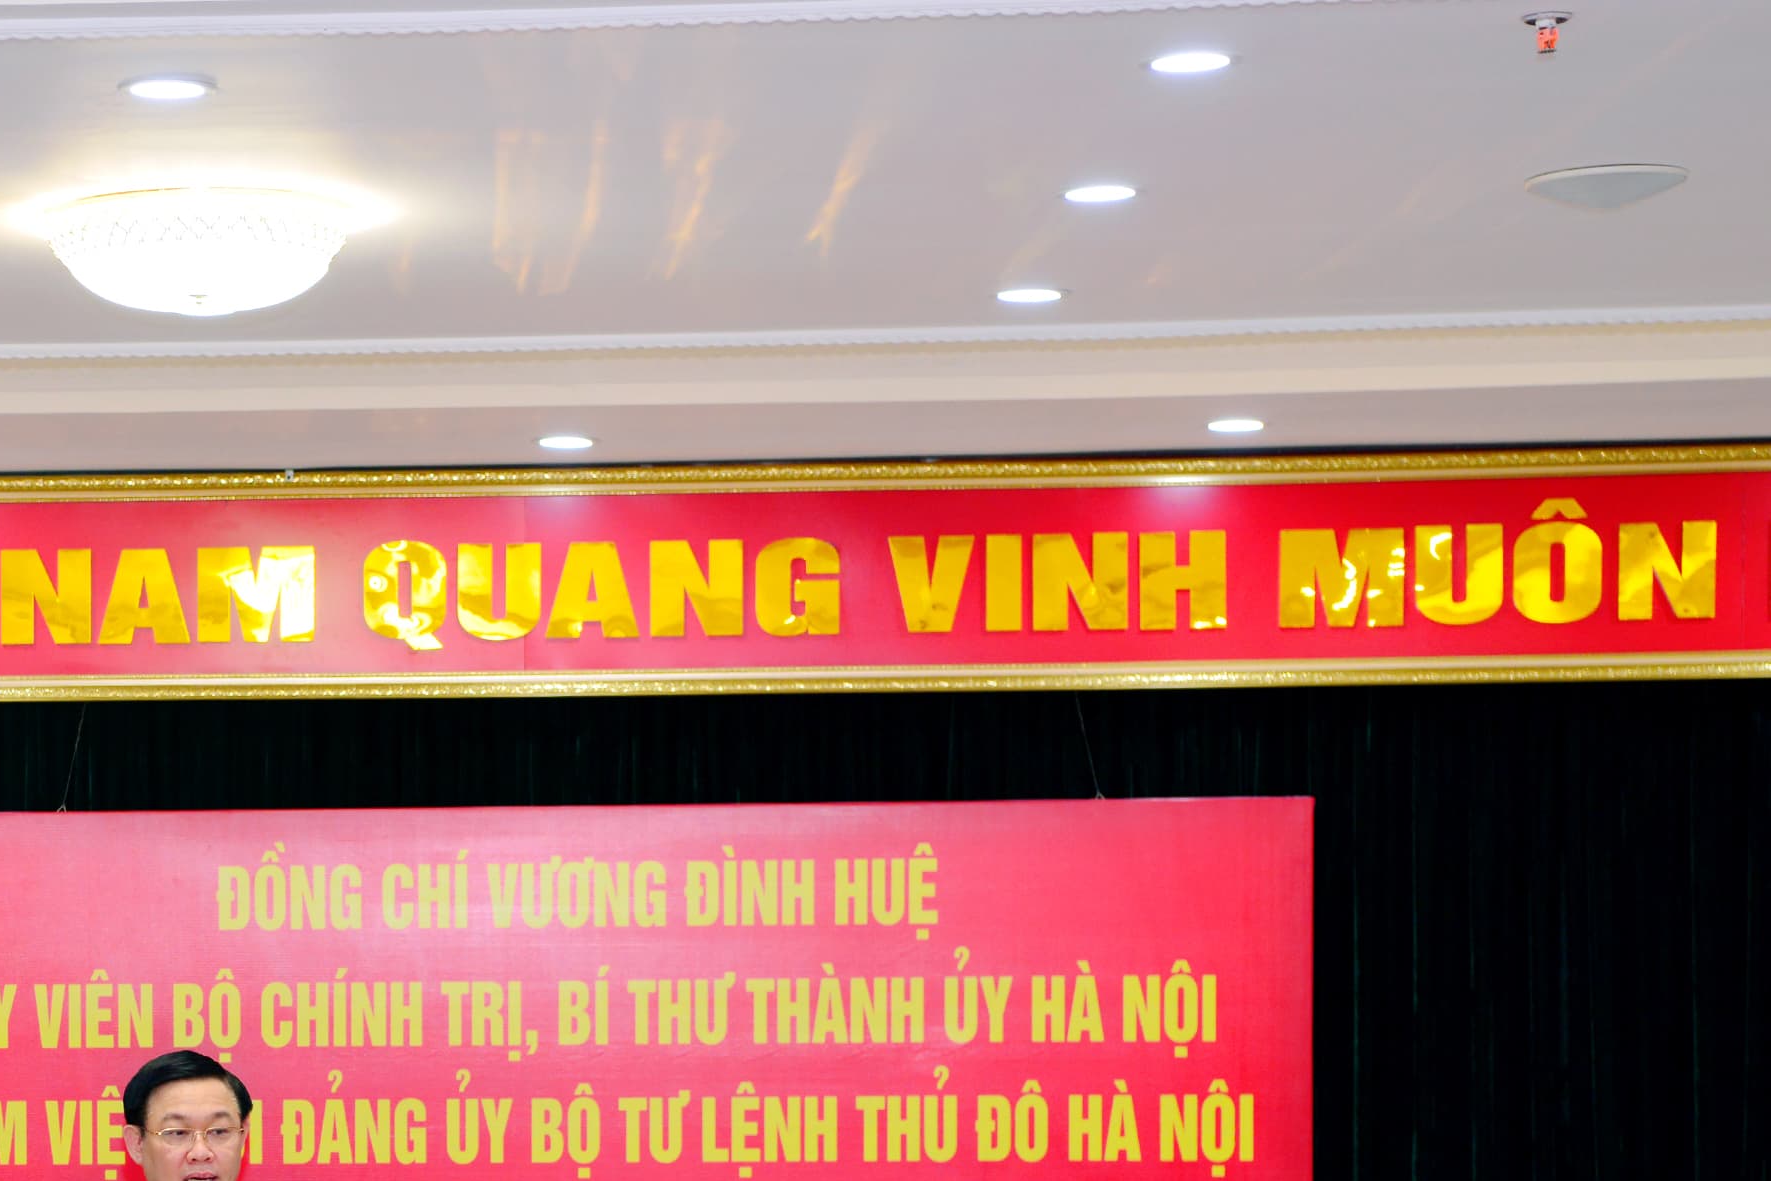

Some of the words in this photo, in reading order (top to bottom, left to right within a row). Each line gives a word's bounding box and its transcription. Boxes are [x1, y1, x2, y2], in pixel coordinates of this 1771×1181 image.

[0, 545, 316, 646] NAM
[362, 537, 840, 651] QUANG
[887, 529, 1227, 633] VINH
[1277, 497, 1718, 632] MUÔN
[216, 842, 362, 931] ĐỒNG
[382, 849, 468, 929] CHÍ
[488, 856, 667, 928] VƯƠNG
[684, 845, 816, 927] ĐÌNH
[834, 843, 939, 941] HUỆ
[34, 969, 154, 1049] VIÊN
[173, 968, 242, 1063] BỘ
[260, 967, 423, 1049] CHÍNH
[441, 980, 539, 1062] TRỊ,
[558, 965, 609, 1046] BÍ
[627, 970, 736, 1045] THƯ
[746, 962, 925, 1045] THÀNH
[944, 946, 1013, 1044] ỦY
[1031, 960, 1105, 1043] HÀ
[1122, 959, 1218, 1058] NỘI
[45, 1085, 127, 1181] VIỆ
[280, 1070, 428, 1165] ĐẢNG
[446, 1069, 513, 1165] ỦY
[531, 1083, 601, 1179] BỘ
[618, 1089, 691, 1164] TƯ
[702, 1081, 839, 1179] LỆNH
[855, 1065, 959, 1163] THỦ
[975, 1079, 1049, 1163] ĐÔ
[1068, 1078, 1142, 1162] HÀ
[1159, 1078, 1255, 1178] NỘI
